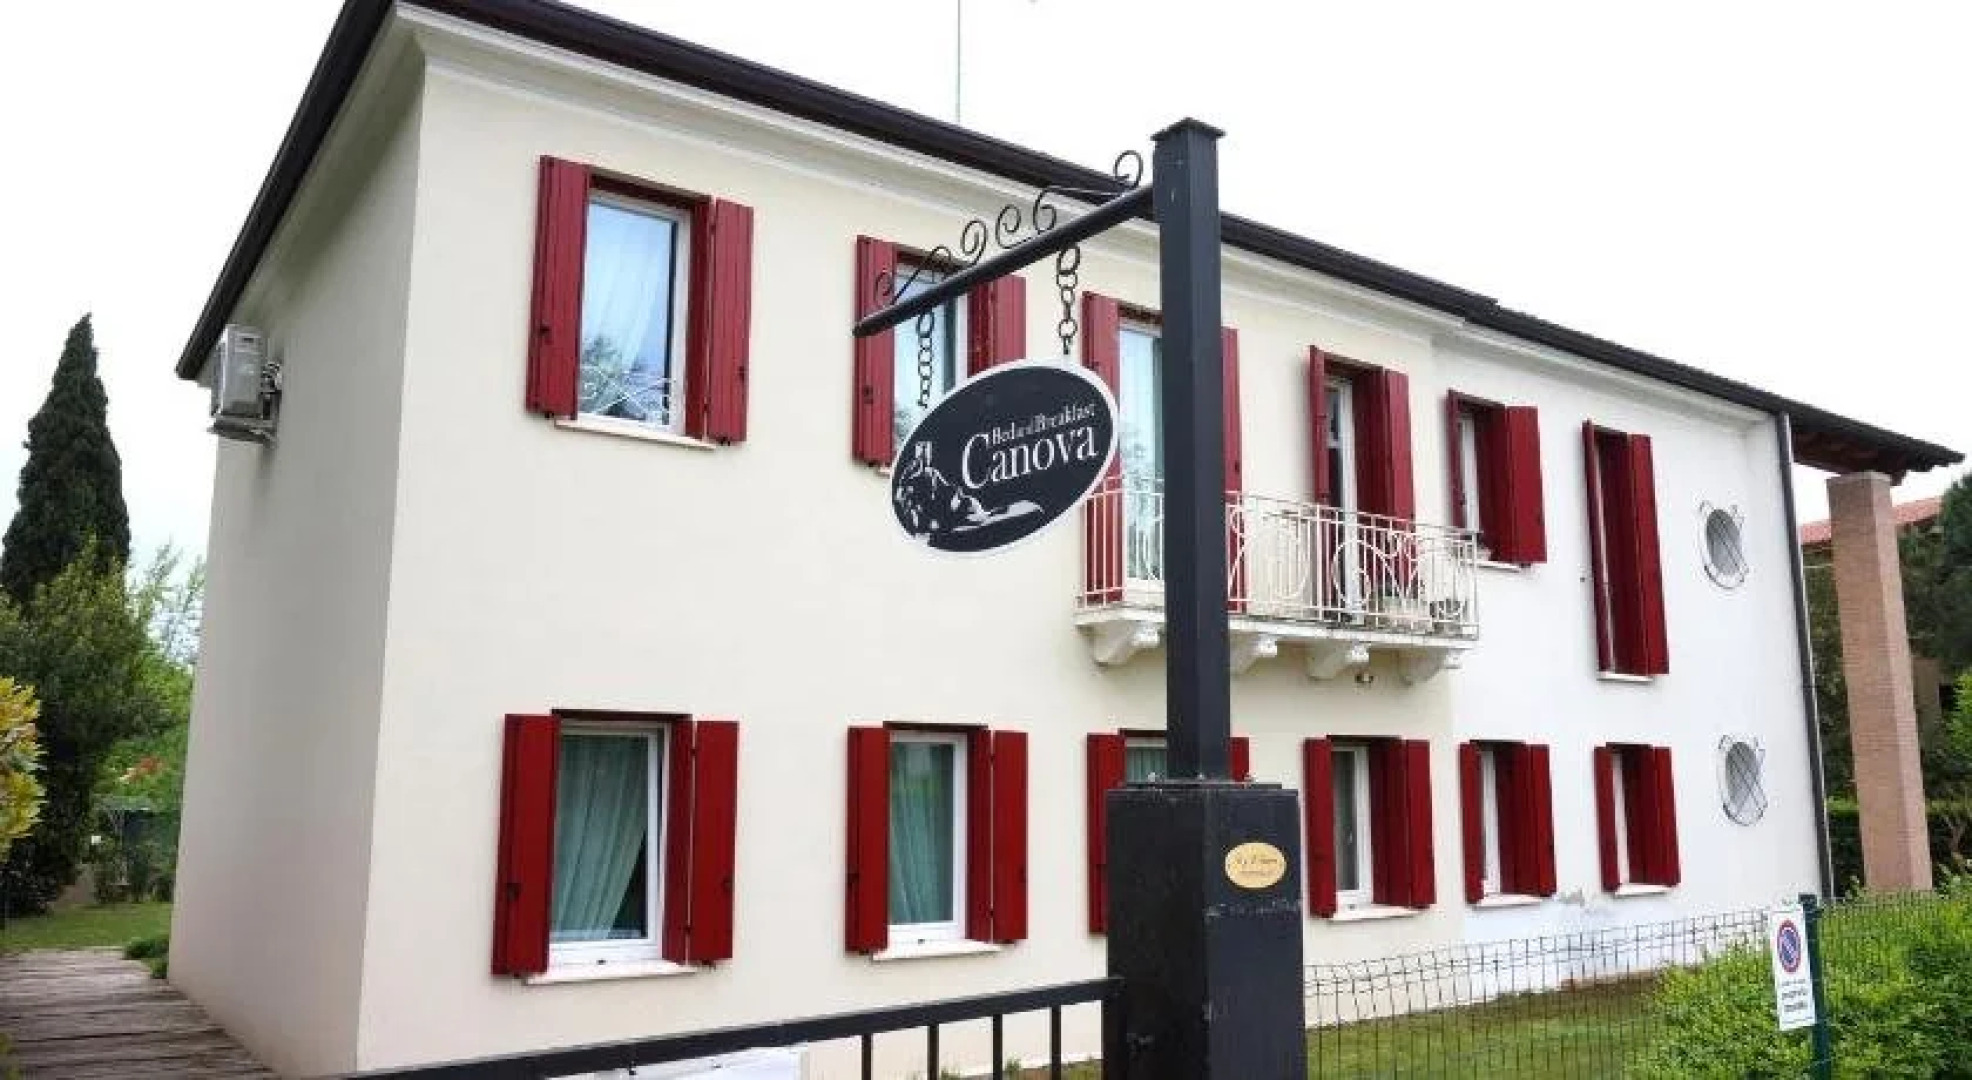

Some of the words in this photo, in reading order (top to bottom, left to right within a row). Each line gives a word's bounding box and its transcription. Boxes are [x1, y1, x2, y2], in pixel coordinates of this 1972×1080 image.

[992, 421, 1015, 444] Bed
[1034, 403, 1096, 433] Breakfast
[962, 426, 1099, 489] Canova
